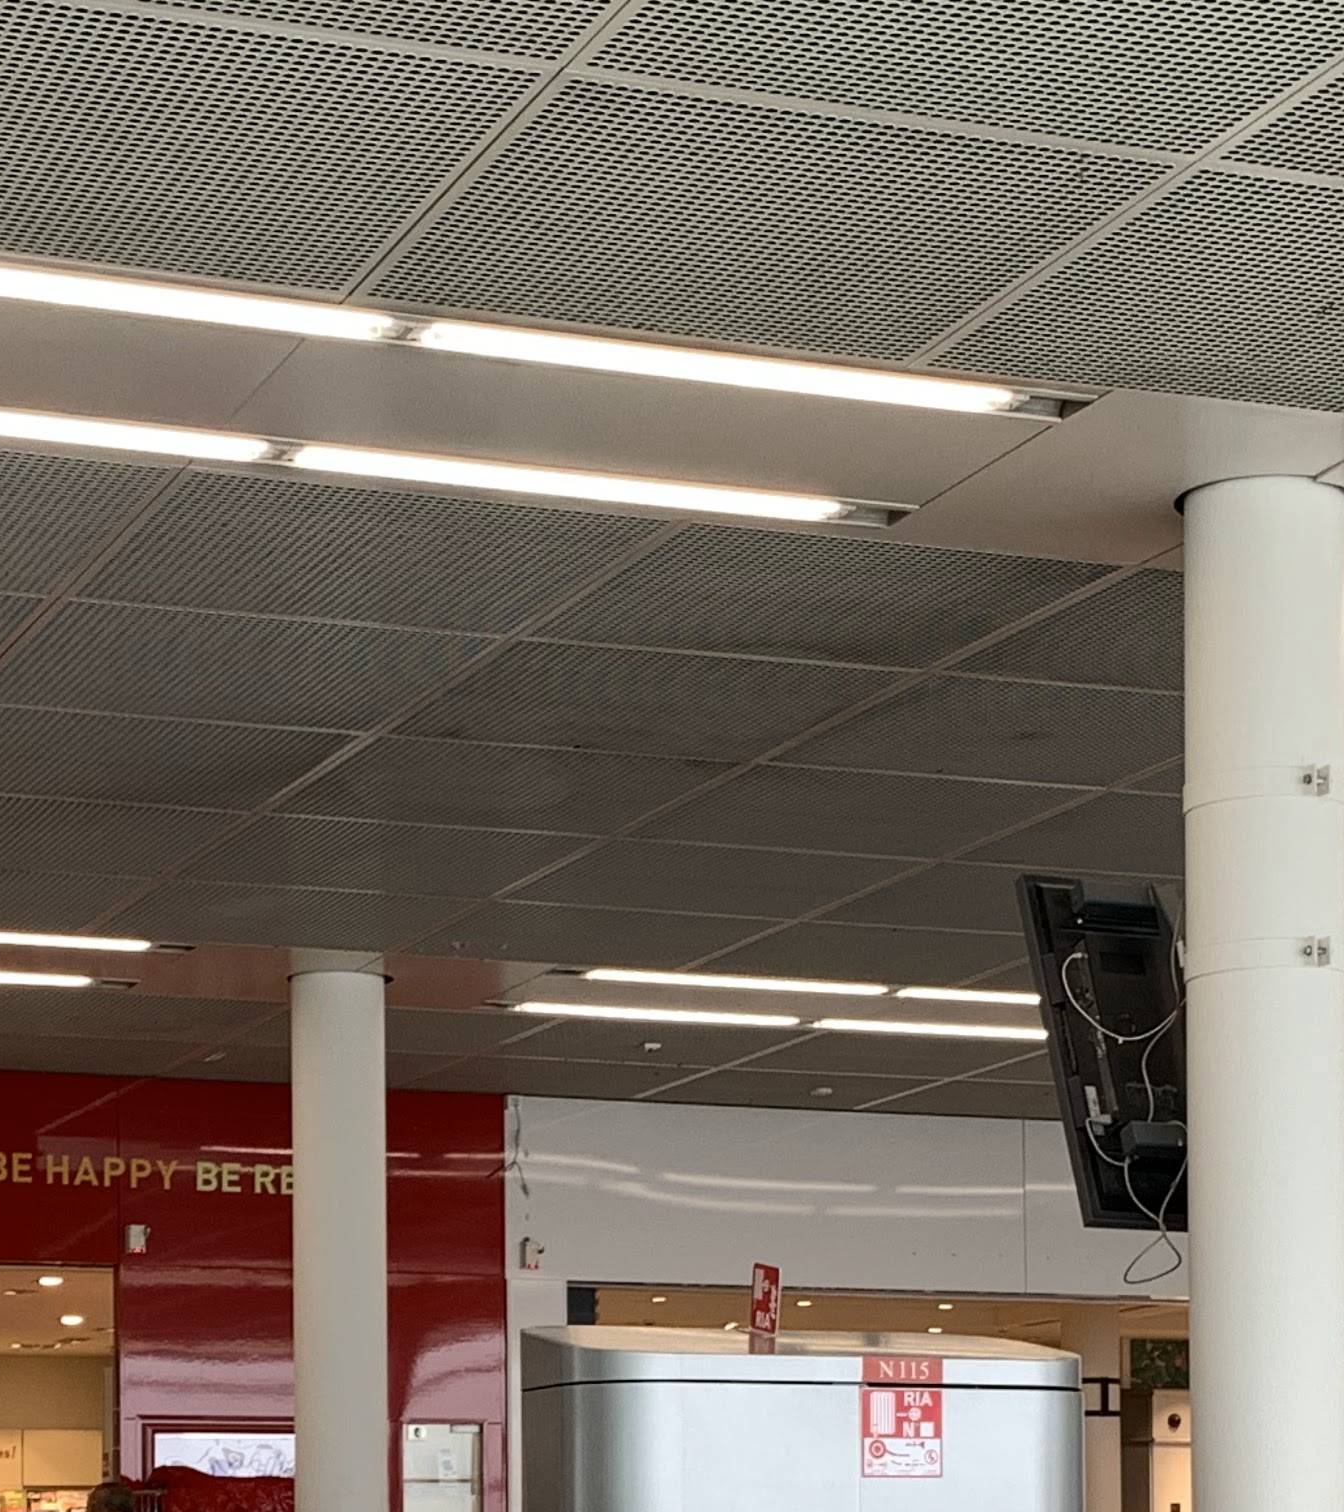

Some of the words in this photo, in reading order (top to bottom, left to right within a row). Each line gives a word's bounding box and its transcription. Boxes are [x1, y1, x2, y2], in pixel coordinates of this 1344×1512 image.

[46, 1155, 177, 1190] HAPPY
[196, 1161, 241, 1193] BE
[903, 1391, 933, 1407] RIA
